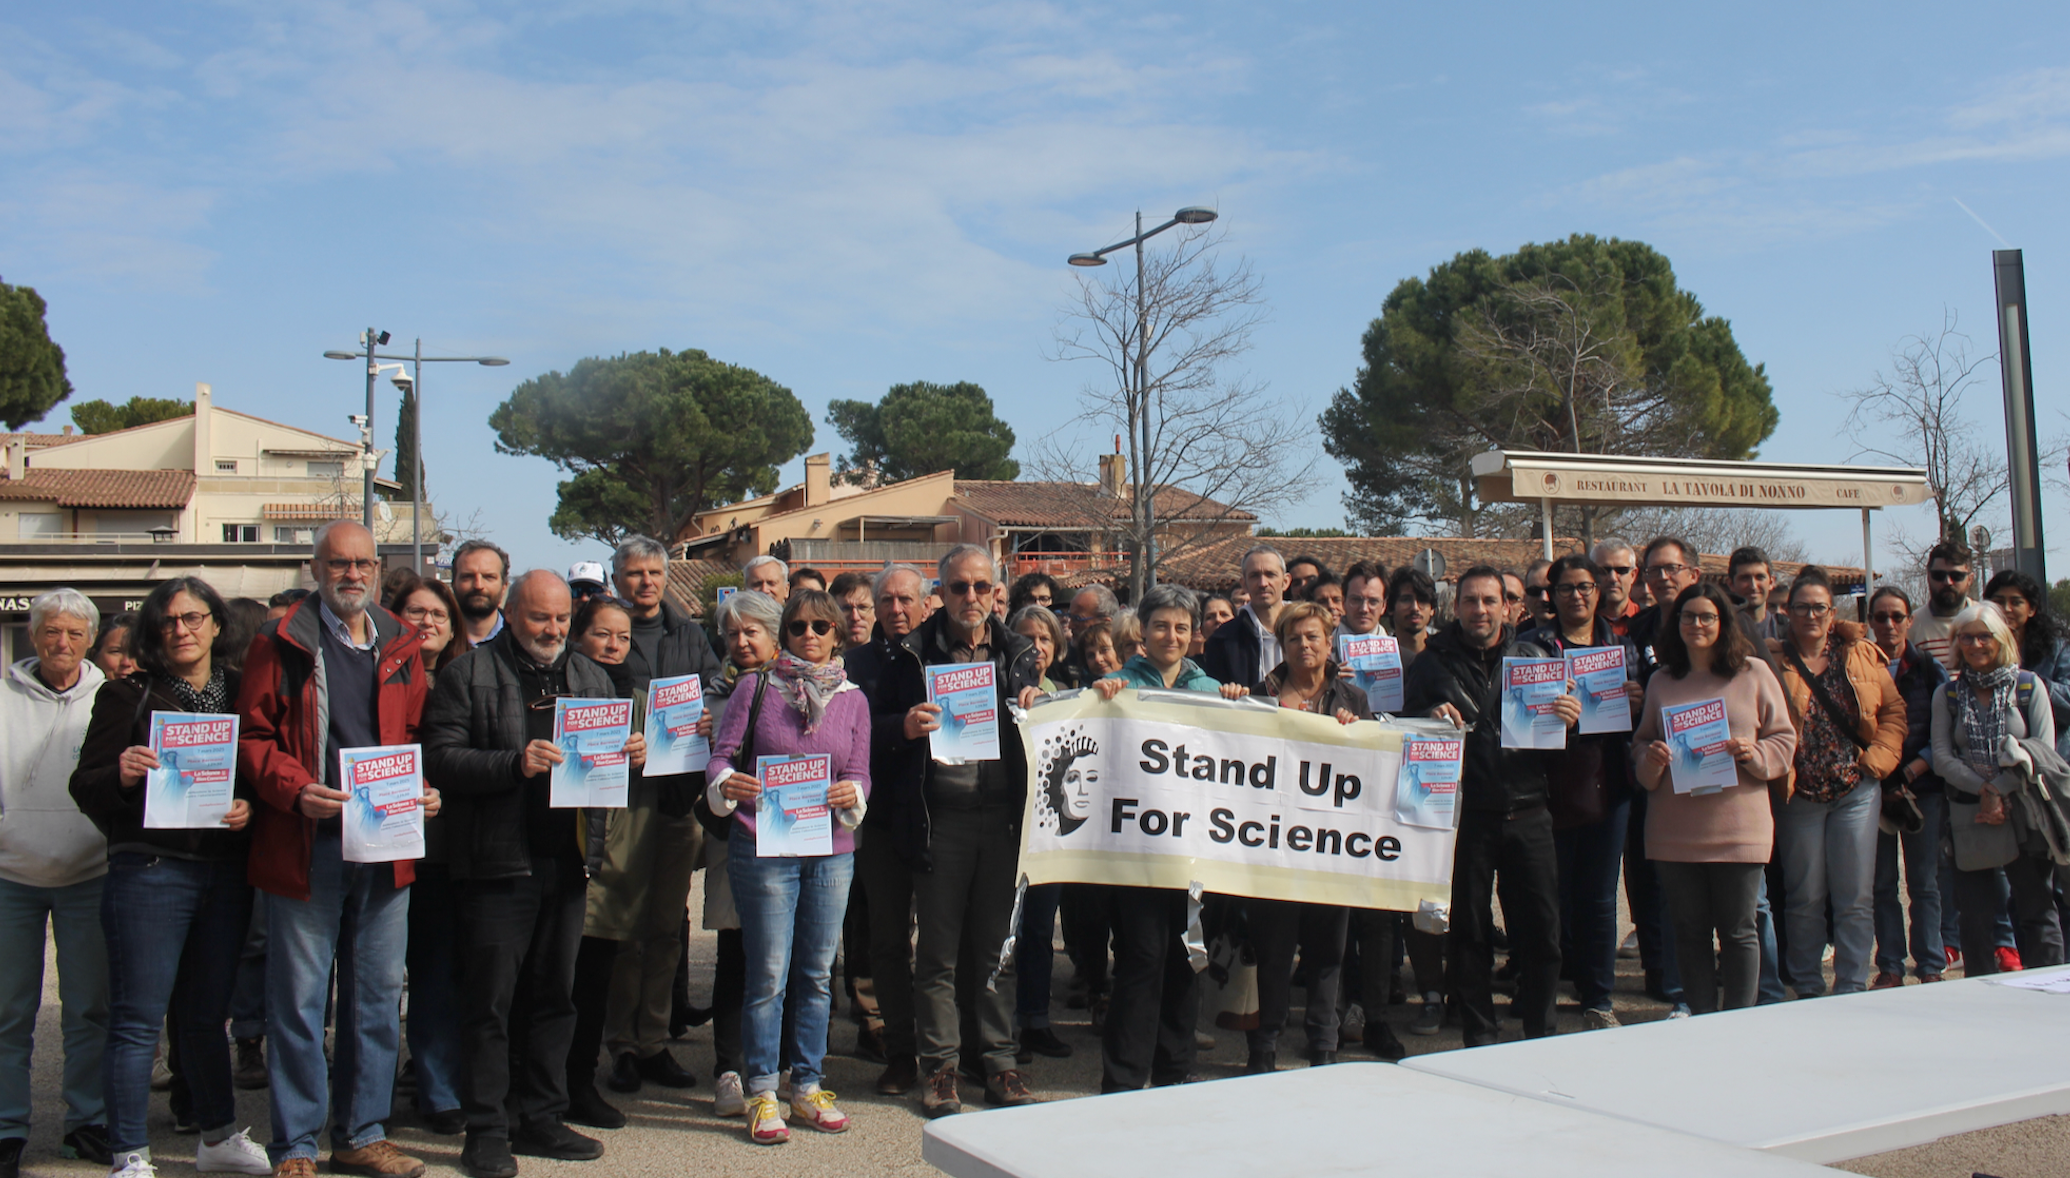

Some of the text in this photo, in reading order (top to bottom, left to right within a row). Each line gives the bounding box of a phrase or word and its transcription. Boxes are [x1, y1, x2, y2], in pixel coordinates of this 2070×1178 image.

[1576, 480, 1647, 492] RESTAURANT
[1662, 482, 1679, 495] LA
[1683, 482, 1735, 496] TAVOLA
[1740, 484, 1754, 497] DI
[1759, 485, 1806, 498] NONNO
[1350, 640, 1380, 649] STAND
[1359, 646, 1394, 654] SCIENCE
[1574, 654, 1606, 666] STAND
[1583, 659, 1621, 672] SCIENCE
[937, 667, 990, 684] STAND UP
[1513, 665, 1547, 675] STAND
[1522, 671, 1562, 683] SCIENCE
[658, 680, 698, 698] STAND UP
[948, 676, 990, 691] SCIENCE
[666, 688, 699, 704] SCIENCE
[568, 705, 627, 720] STAND UP
[1674, 702, 1721, 723] STAND UP
[1683, 710, 1722, 728] SCIENCE
[578, 714, 625, 728] SCIENCE
[166, 722, 230, 736] STAND UP
[177, 732, 229, 745] SCIENCE
[1412, 743, 1444, 751] STAND
[1419, 751, 1457, 759] SCIENCE
[356, 754, 412, 772] STAND UP
[768, 760, 825, 776] STAND UP
[368, 763, 412, 780] SCIENCE
[778, 769, 824, 783] SCIENCE
[1140, 739, 1361, 807] Stand Up
[1111, 798, 1401, 861] For Science
